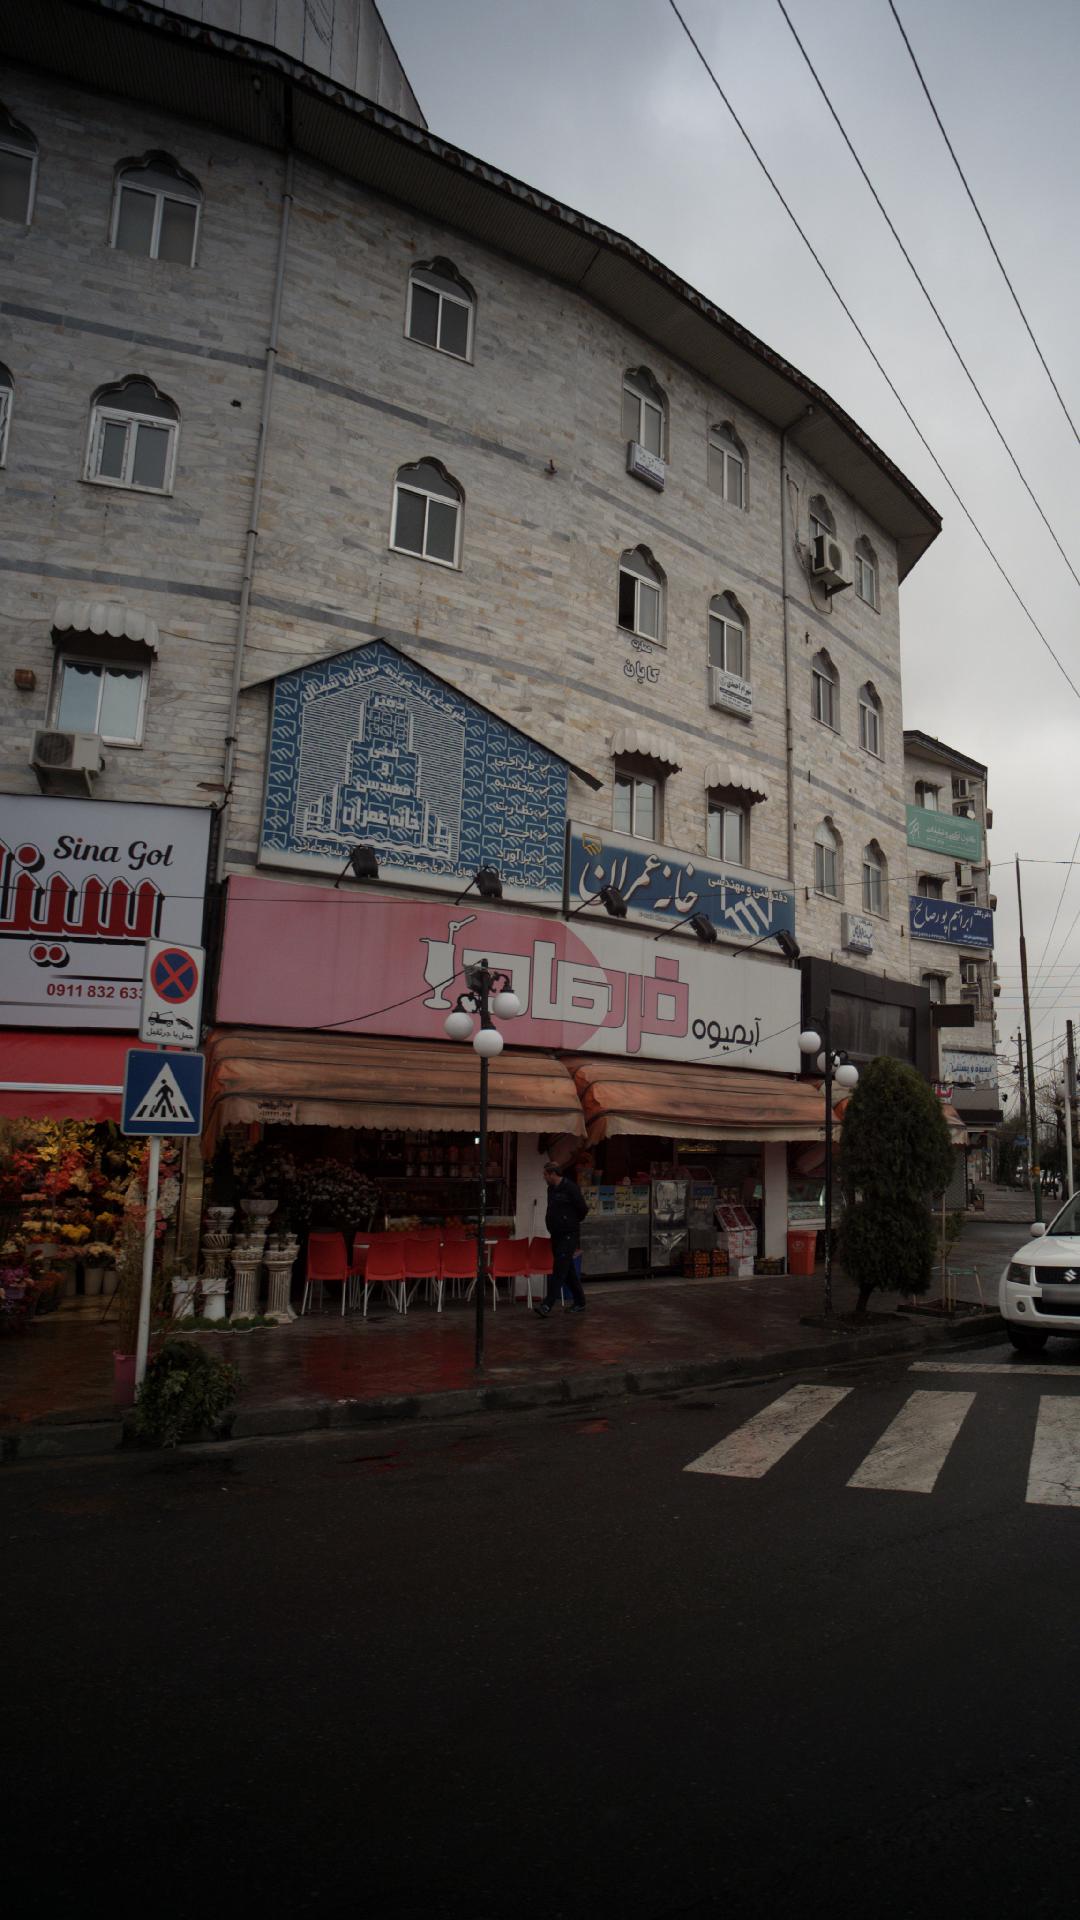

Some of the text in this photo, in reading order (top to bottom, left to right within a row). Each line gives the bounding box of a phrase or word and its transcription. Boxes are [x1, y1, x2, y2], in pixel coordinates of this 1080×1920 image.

[374, 695, 406, 710] دفتر
[369, 743, 399, 758] فنی
[494, 756, 535, 771] طراحی
[356, 780, 411, 797] مهندسی
[494, 778, 535, 794] محاسبه
[342, 797, 420, 831] خانه عمران
[495, 801, 533, 816] نظارت
[498, 823, 533, 838] اجرا
[53, 835, 173, 870] Sina Gol
[293, 842, 345, 859] ساختمانی
[406, 859, 429, 873] جهت
[509, 876, 531, 887] انجام
[578, 853, 699, 914] خانه عمران
[707, 875, 746, 894] مهندسی
[768, 892, 789, 904] دفتر
[948, 908, 974, 940] ابراهیم
[47, 983, 83, 998] 0911
[87, 986, 114, 999] 832
[146, 1028, 194, 1040] حمل با جرثقیل
[692, 1017, 762, 1053] آبمیوه
